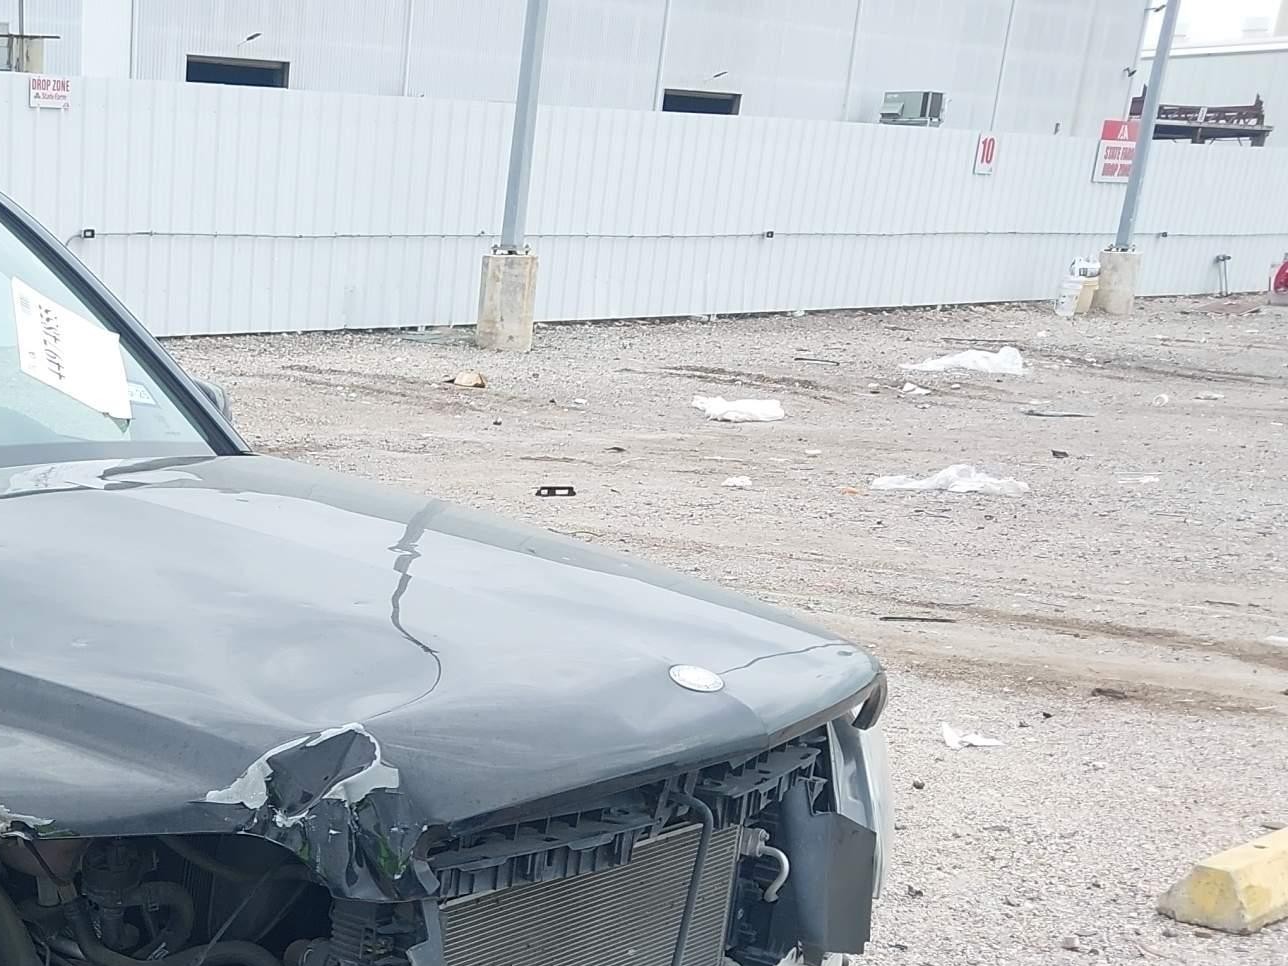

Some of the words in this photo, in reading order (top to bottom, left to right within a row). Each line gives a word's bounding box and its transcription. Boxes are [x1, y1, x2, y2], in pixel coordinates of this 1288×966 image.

[32, 78, 51, 90] DROP
[52, 79, 70, 92] ZONE
[980, 137, 995, 164] 10
